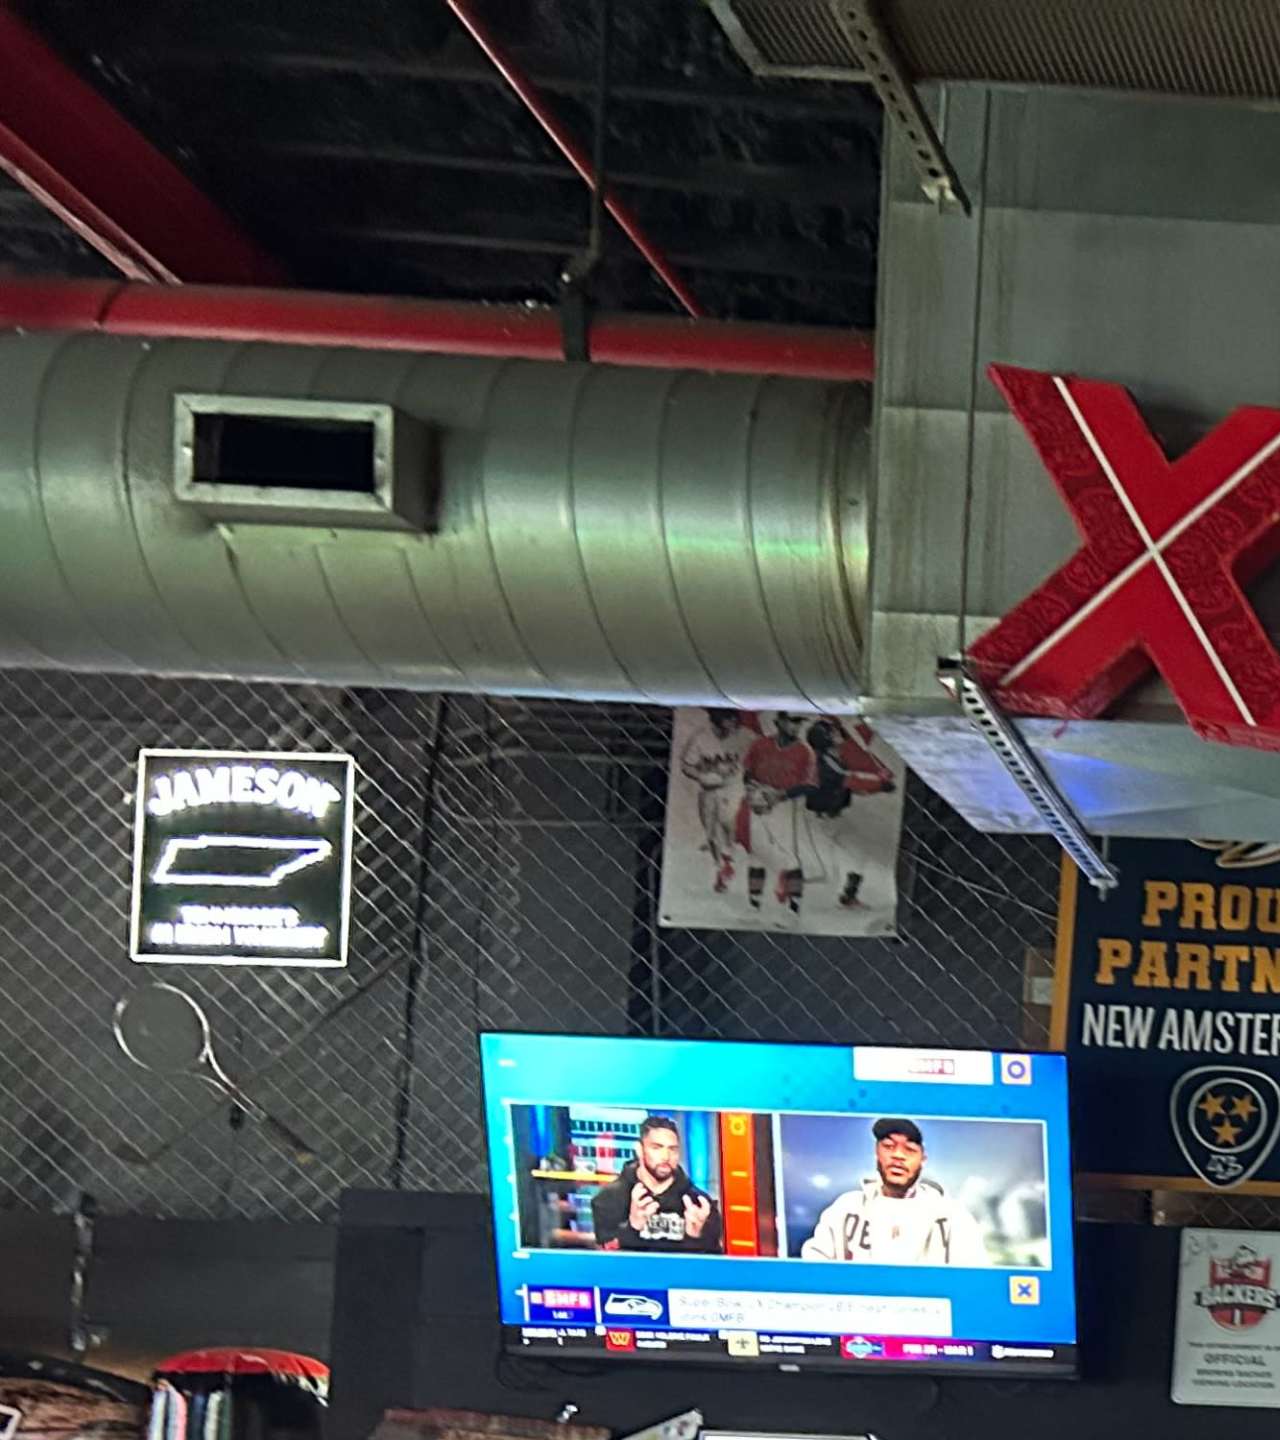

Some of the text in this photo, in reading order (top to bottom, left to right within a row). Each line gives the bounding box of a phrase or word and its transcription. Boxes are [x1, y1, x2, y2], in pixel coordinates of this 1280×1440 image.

[148, 765, 341, 818] JAMESON
[1081, 1003, 1154, 1050] NEW
[1204, 1353, 1267, 1367] OFFICIAL
